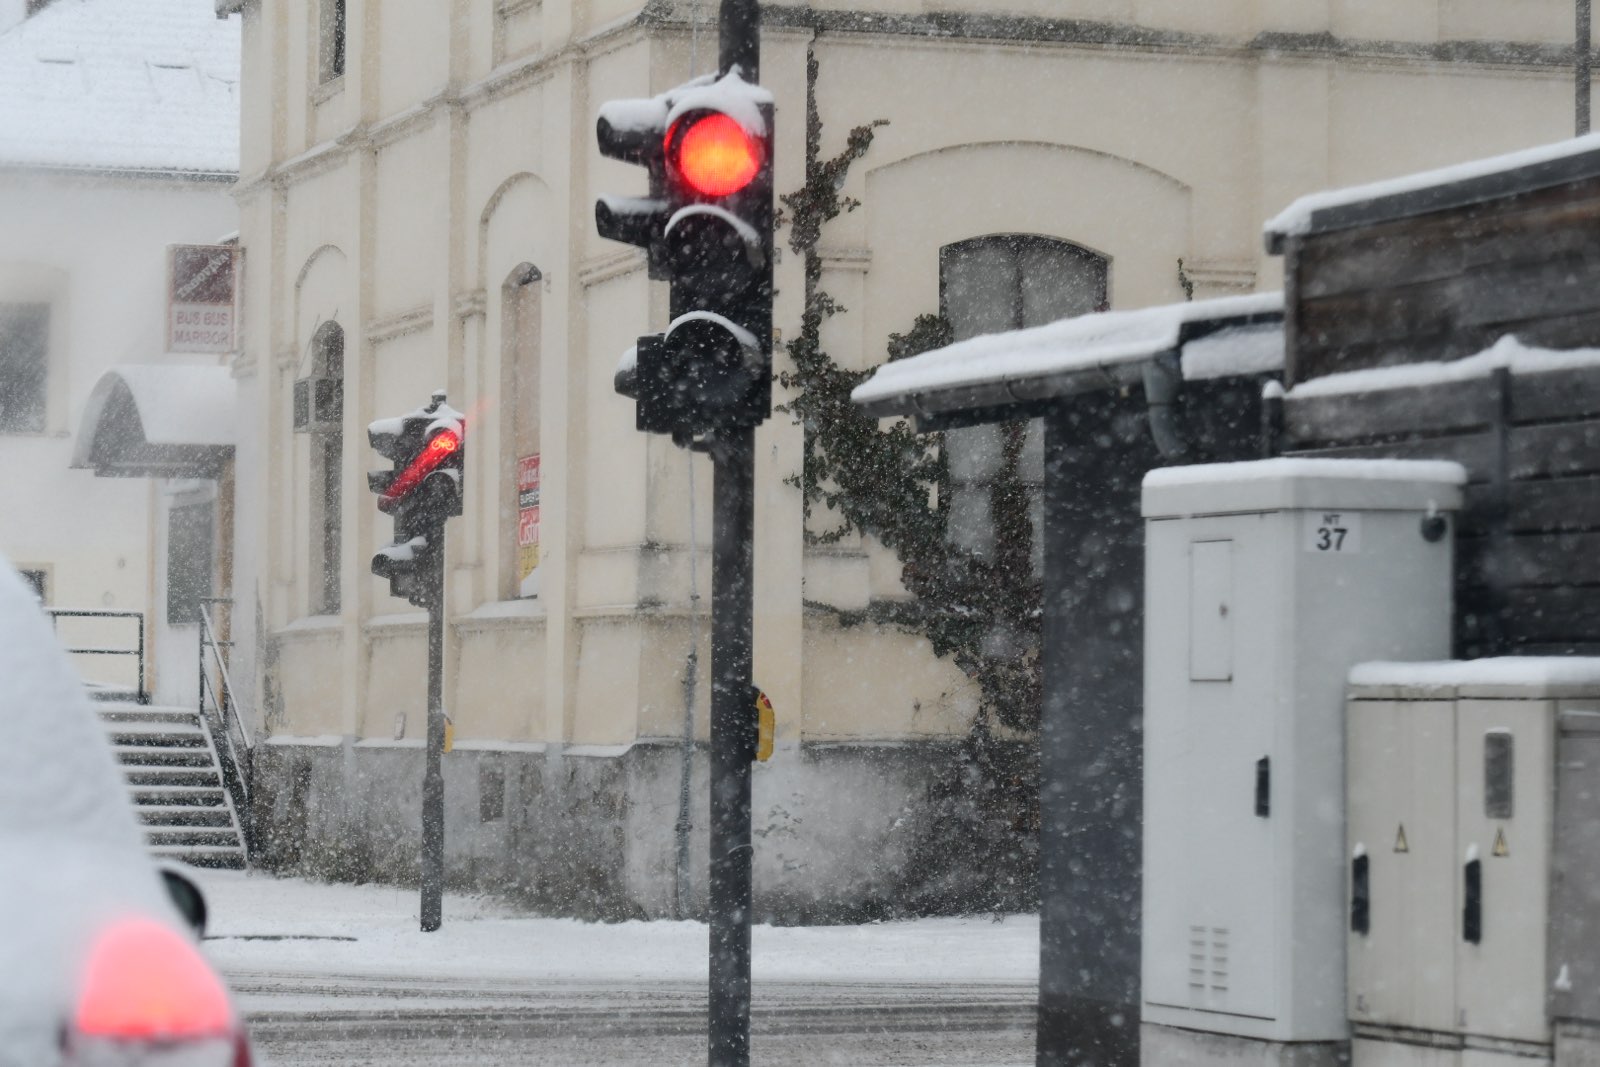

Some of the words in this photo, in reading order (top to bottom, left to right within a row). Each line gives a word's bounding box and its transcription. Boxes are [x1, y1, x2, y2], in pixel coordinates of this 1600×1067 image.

[177, 312, 200, 325] BUS
[204, 312, 228, 326] BUS
[175, 330, 229, 345] MARIBOR
[1317, 527, 1348, 551] 37
